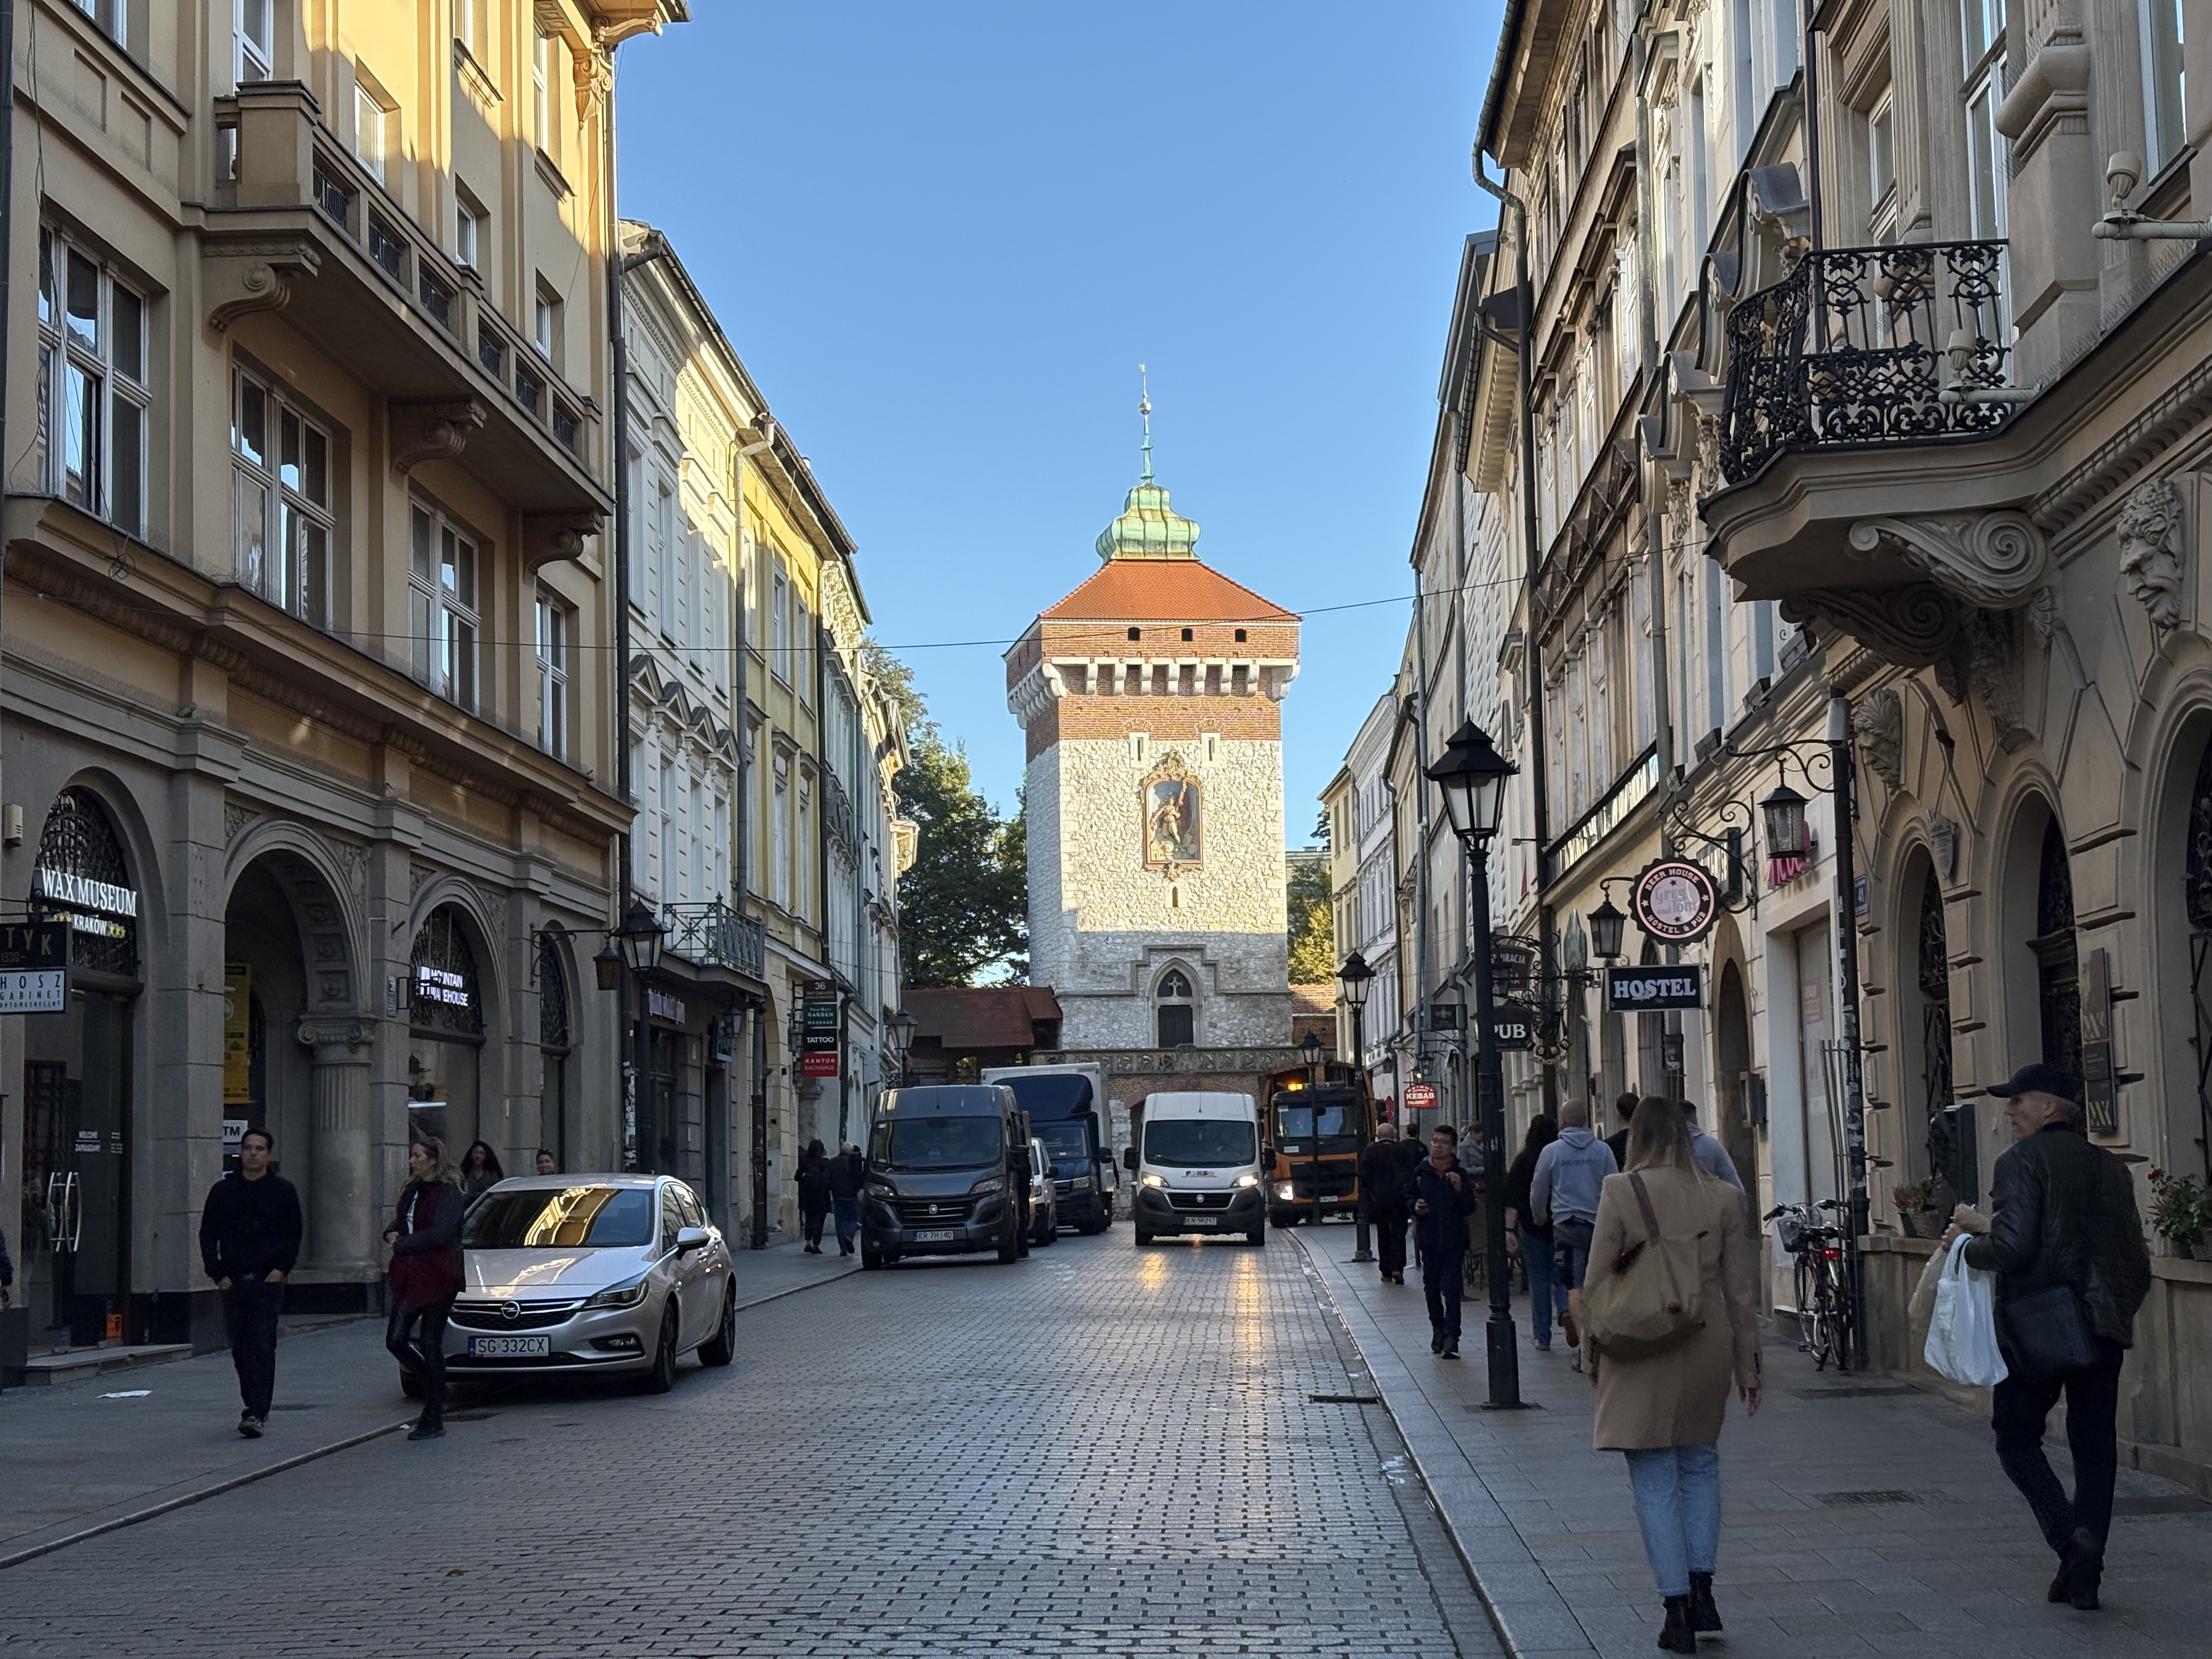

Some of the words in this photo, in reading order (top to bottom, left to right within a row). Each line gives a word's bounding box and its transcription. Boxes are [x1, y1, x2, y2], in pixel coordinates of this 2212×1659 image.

[1645, 871, 1667, 891] BEER
[1669, 869, 1699, 883] HOUSE
[41, 868, 75, 901] WAX
[77, 877, 137, 917] MUSEUM
[1655, 887, 1687, 904] Greg
[1671, 899, 1696, 913] Tom
[74, 914, 107, 936] KRAKÓW
[1647, 915, 1680, 933] HOSTEL
[1691, 911, 1706, 927] PUB
[0, 974, 60, 989] HOSZ
[815, 982, 826, 990] 36
[1613, 978, 1696, 999] HOSTEL
[0, 990, 60, 1000] GABINET
[431, 987, 469, 1006] WAEHOUSE
[478, 1339, 497, 1353] SG
[501, 1338, 545, 1353] 332CX
